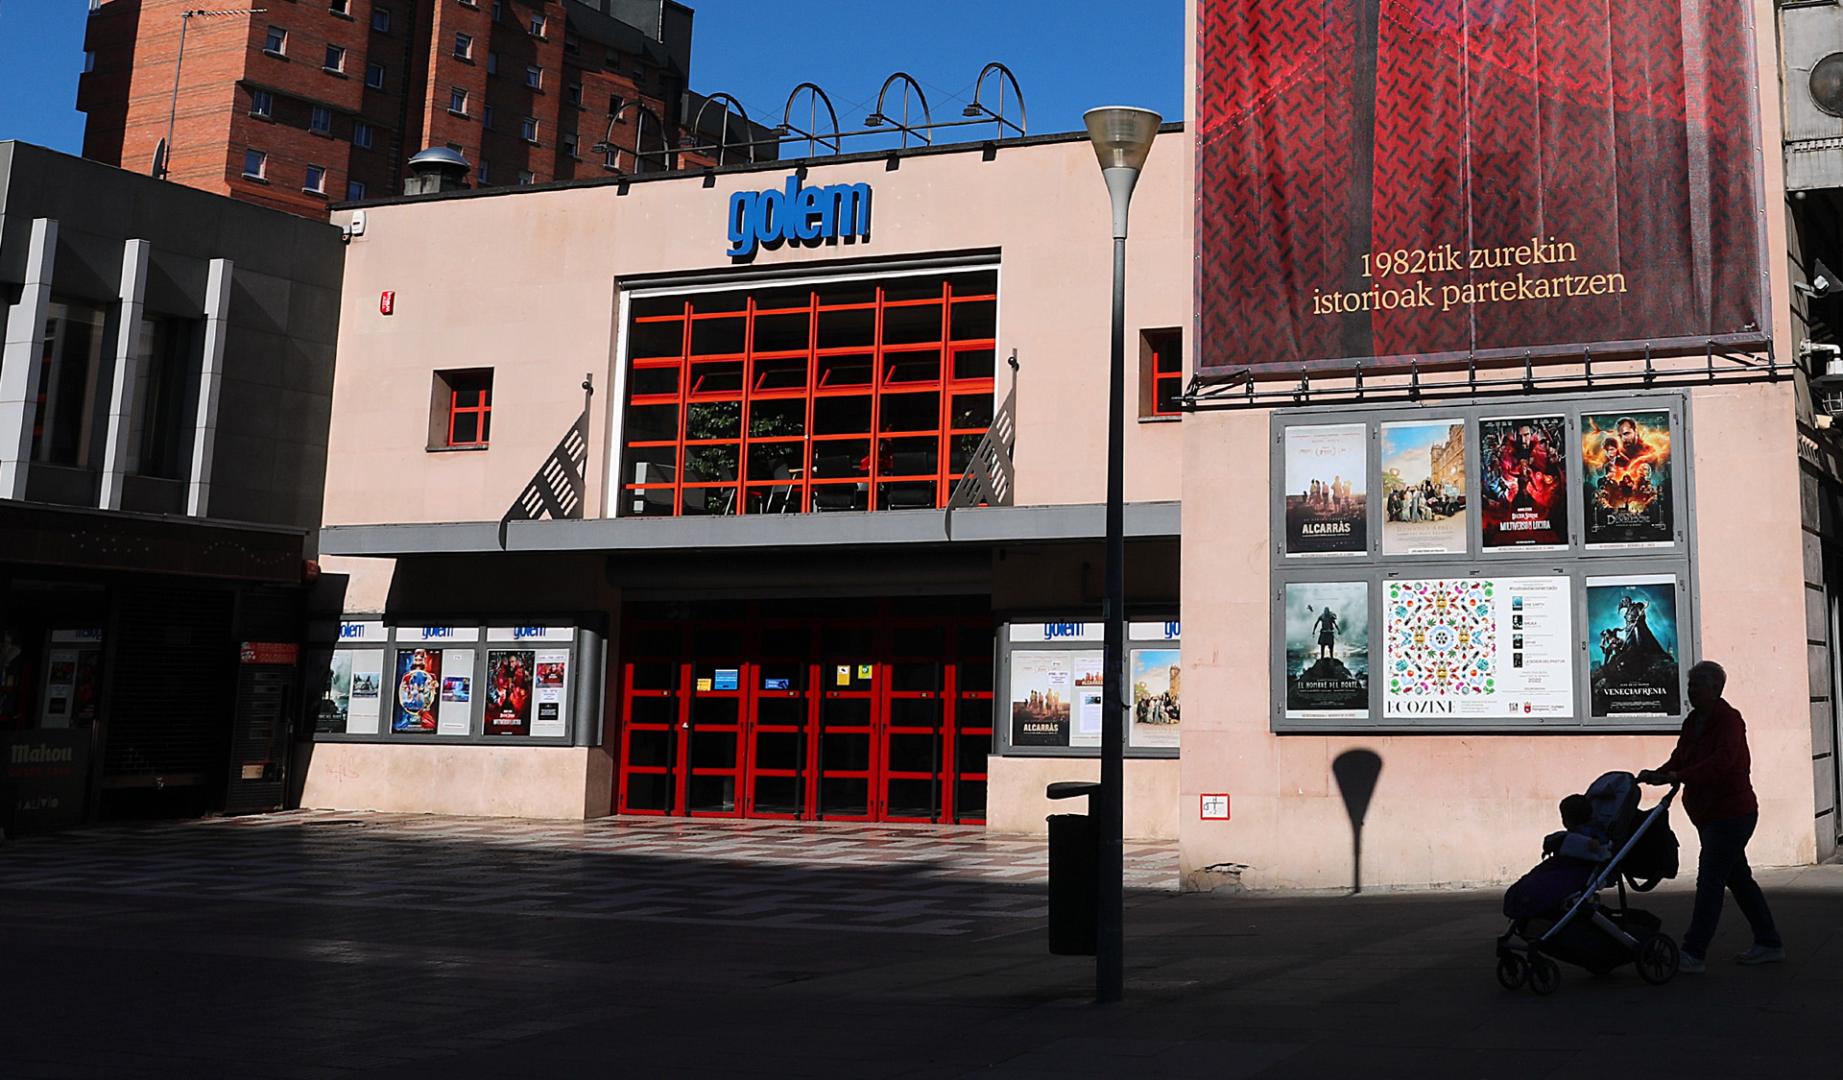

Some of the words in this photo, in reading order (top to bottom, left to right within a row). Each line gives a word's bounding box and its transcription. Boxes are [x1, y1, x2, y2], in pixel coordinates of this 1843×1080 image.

[727, 175, 871, 257] golem
[1361, 245, 1463, 277] 1982tik
[1469, 236, 1577, 269] zurekin
[1312, 281, 1435, 315] istorioak
[1441, 272, 1628, 311] partekartzen
[1301, 520, 1352, 535] ALCARRÀS
[338, 621, 365, 638] olem
